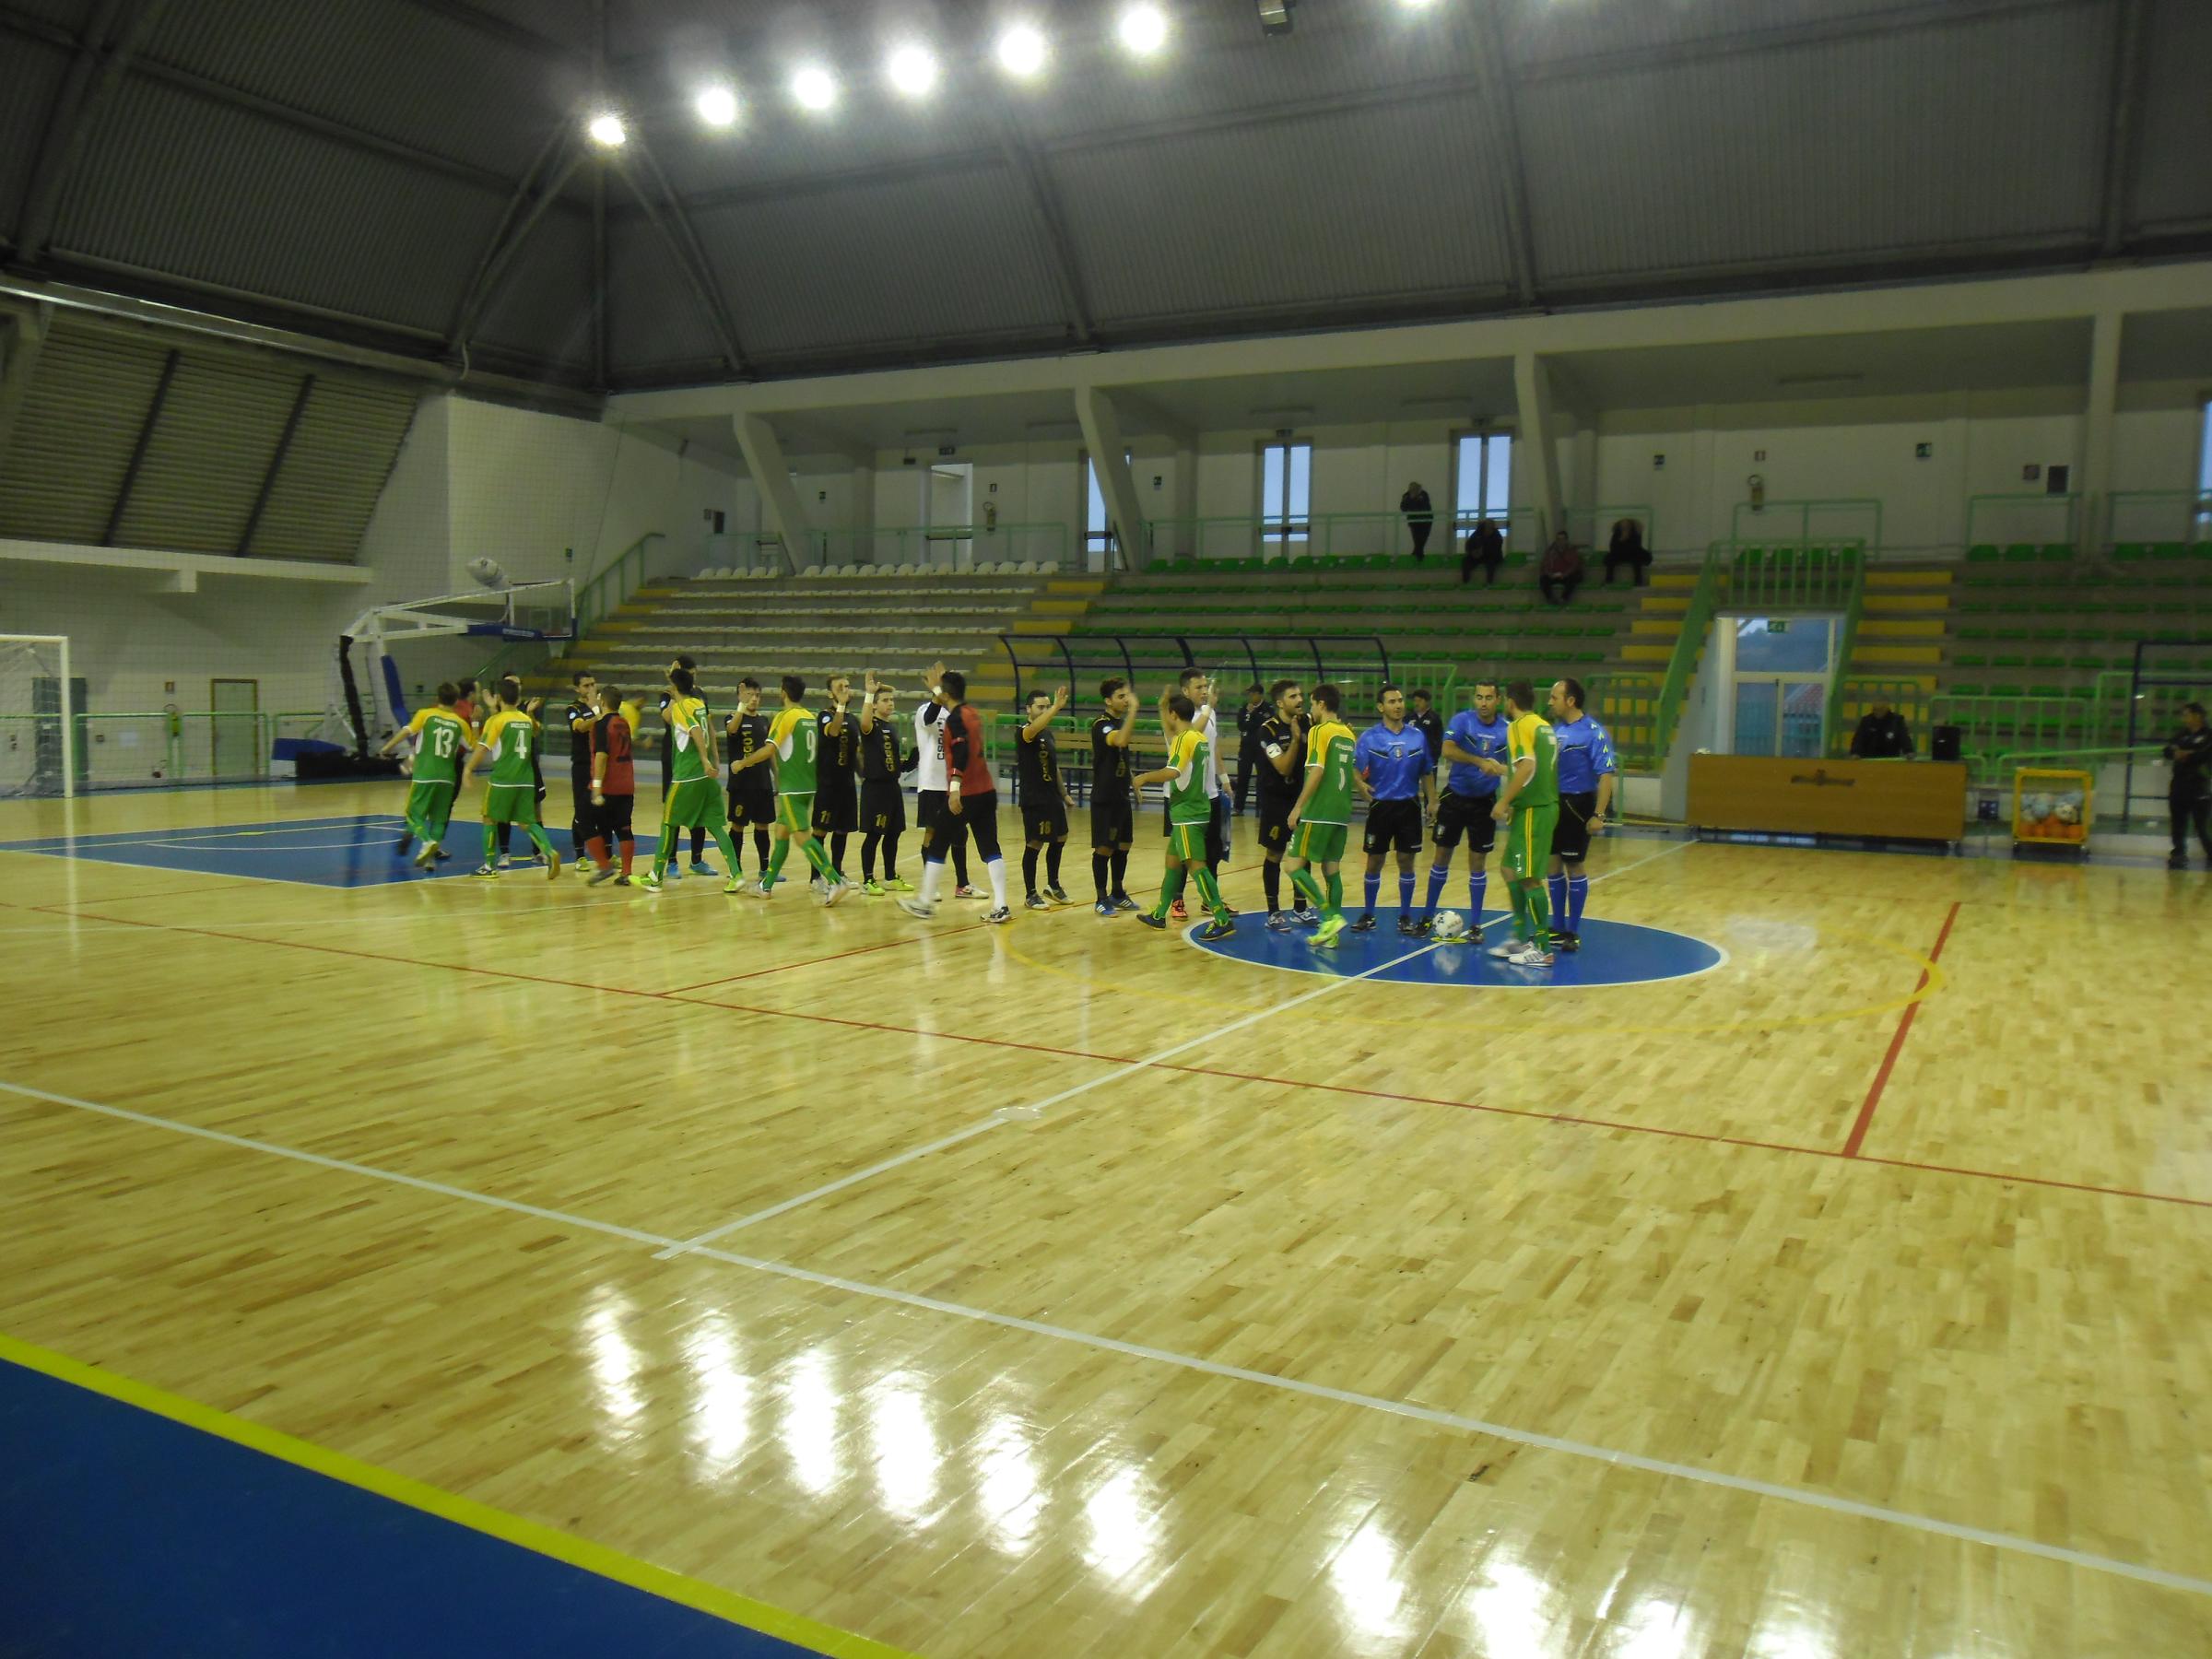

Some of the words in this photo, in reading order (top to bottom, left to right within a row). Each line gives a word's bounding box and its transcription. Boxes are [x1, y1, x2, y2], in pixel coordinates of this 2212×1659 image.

[433, 726, 454, 759] 13
[513, 730, 528, 759] 4
[806, 730, 818, 764] 9
